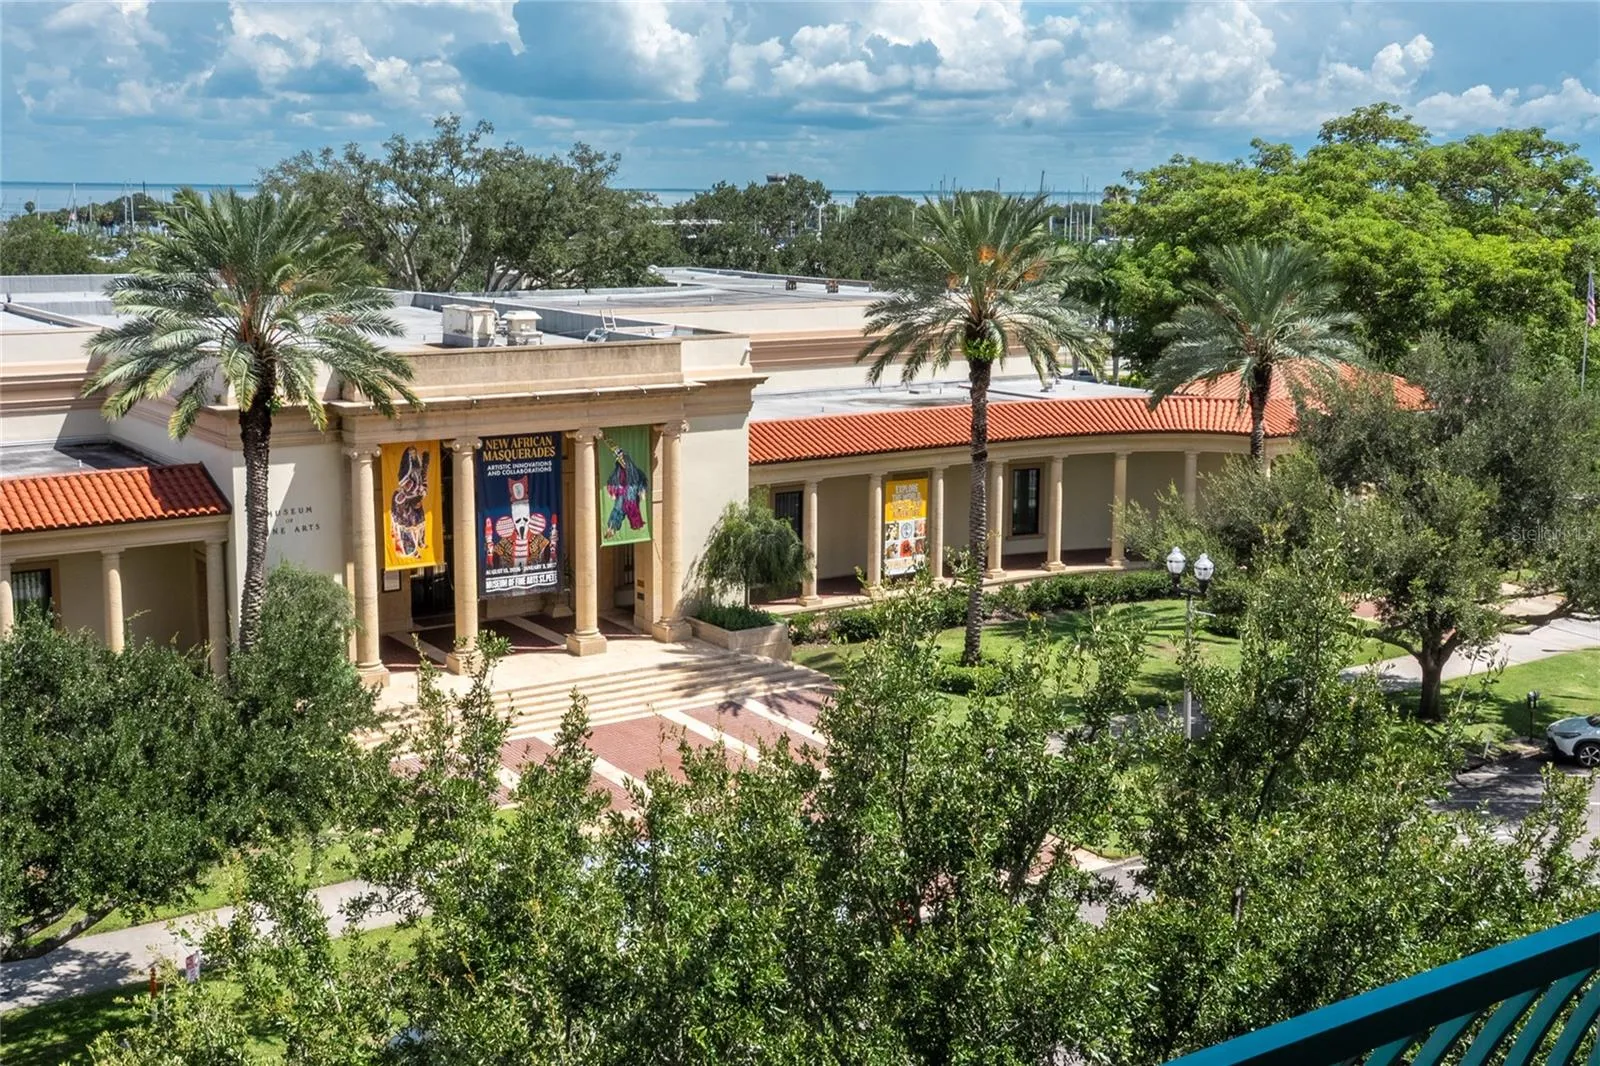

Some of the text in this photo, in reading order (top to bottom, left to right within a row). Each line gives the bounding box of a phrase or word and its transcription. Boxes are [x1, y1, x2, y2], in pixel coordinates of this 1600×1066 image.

[486, 436, 552, 450] NEW AFRICAN
[483, 446, 556, 462] MASQUERADES
[487, 460, 552, 471] ARTISTIC INNOVATIONS
[501, 466, 552, 476] COLLABORATIONS
[294, 523, 320, 533] ARTS
[486, 578, 508, 589] MUSEUM
[508, 577, 515, 587] OF
[515, 576, 526, 586] FINE
[527, 575, 538, 585] ARTS
